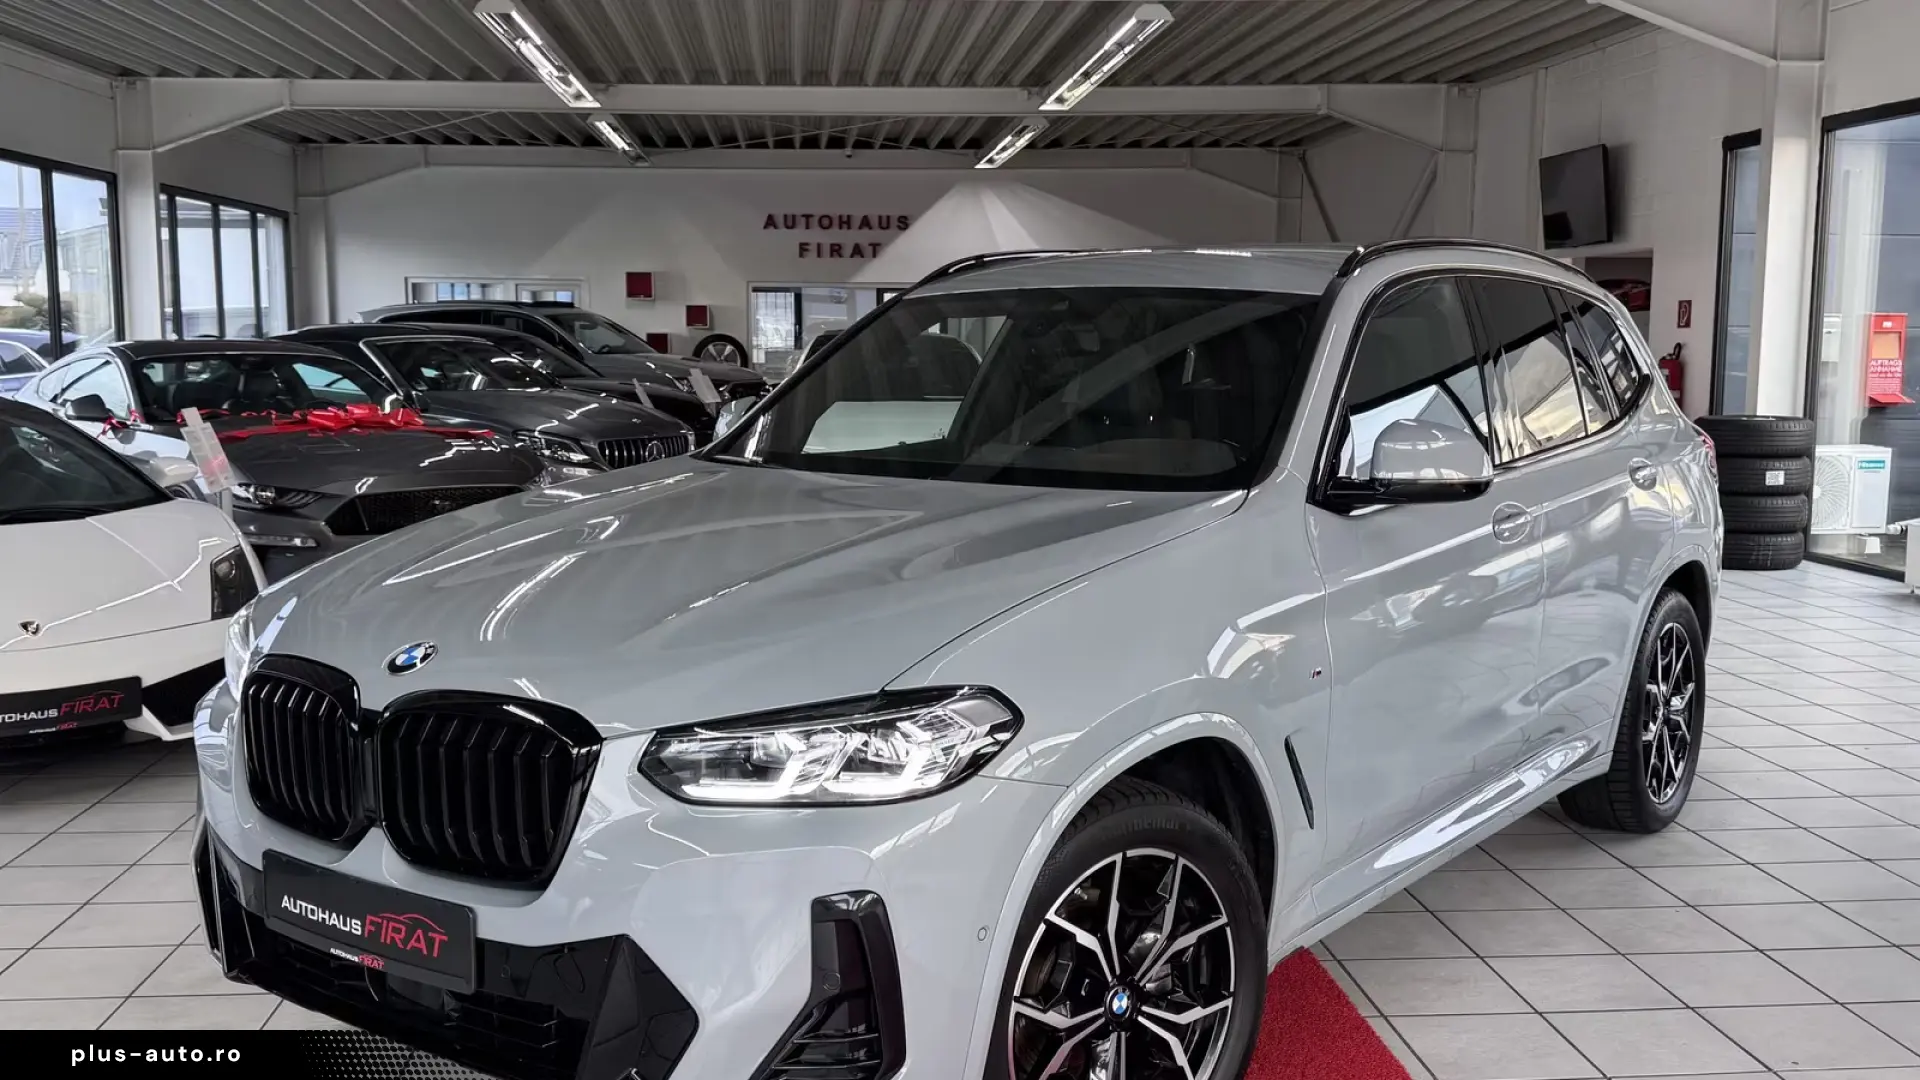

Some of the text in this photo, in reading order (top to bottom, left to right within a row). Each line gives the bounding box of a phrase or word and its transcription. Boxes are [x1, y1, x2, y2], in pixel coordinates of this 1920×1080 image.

[763, 214, 910, 231] AUTOHAUS
[798, 242, 882, 259] FIRAT
[60, 695, 124, 717] FIRAT
[281, 895, 448, 958] AUTOHAUS FIRAT
[358, 954, 384, 969] FIRAT
